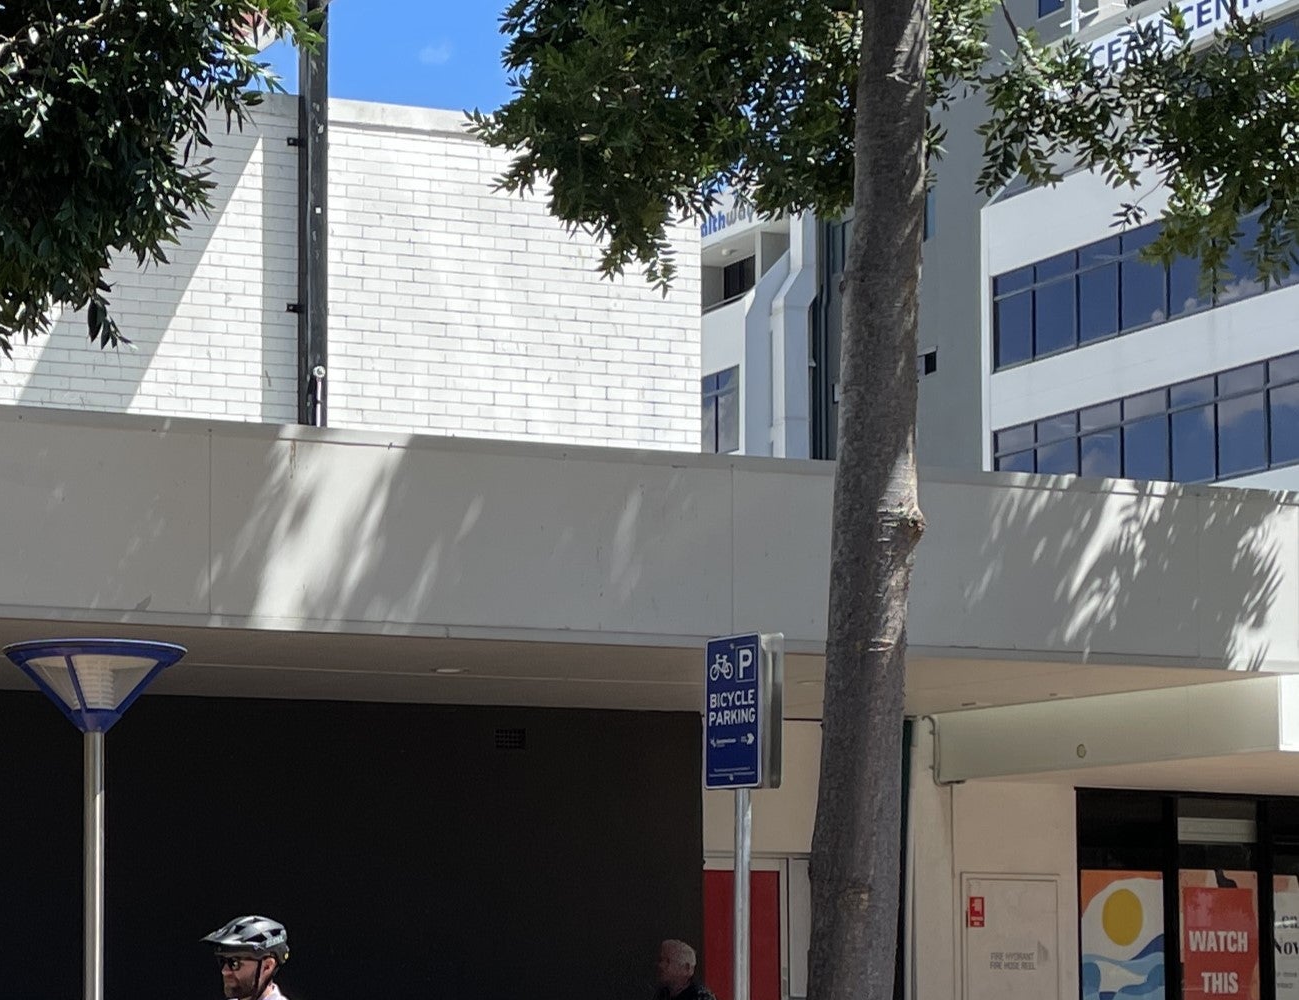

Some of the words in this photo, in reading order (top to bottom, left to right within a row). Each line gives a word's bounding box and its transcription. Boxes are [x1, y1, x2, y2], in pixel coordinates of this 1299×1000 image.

[1181, 0, 1263, 32] CEN
[739, 649, 753, 679] P
[709, 689, 755, 709] BICYCLE
[709, 708, 756, 727] PARKING
[1188, 930, 1248, 953] WATCH
[1201, 972, 1239, 994] THIS
